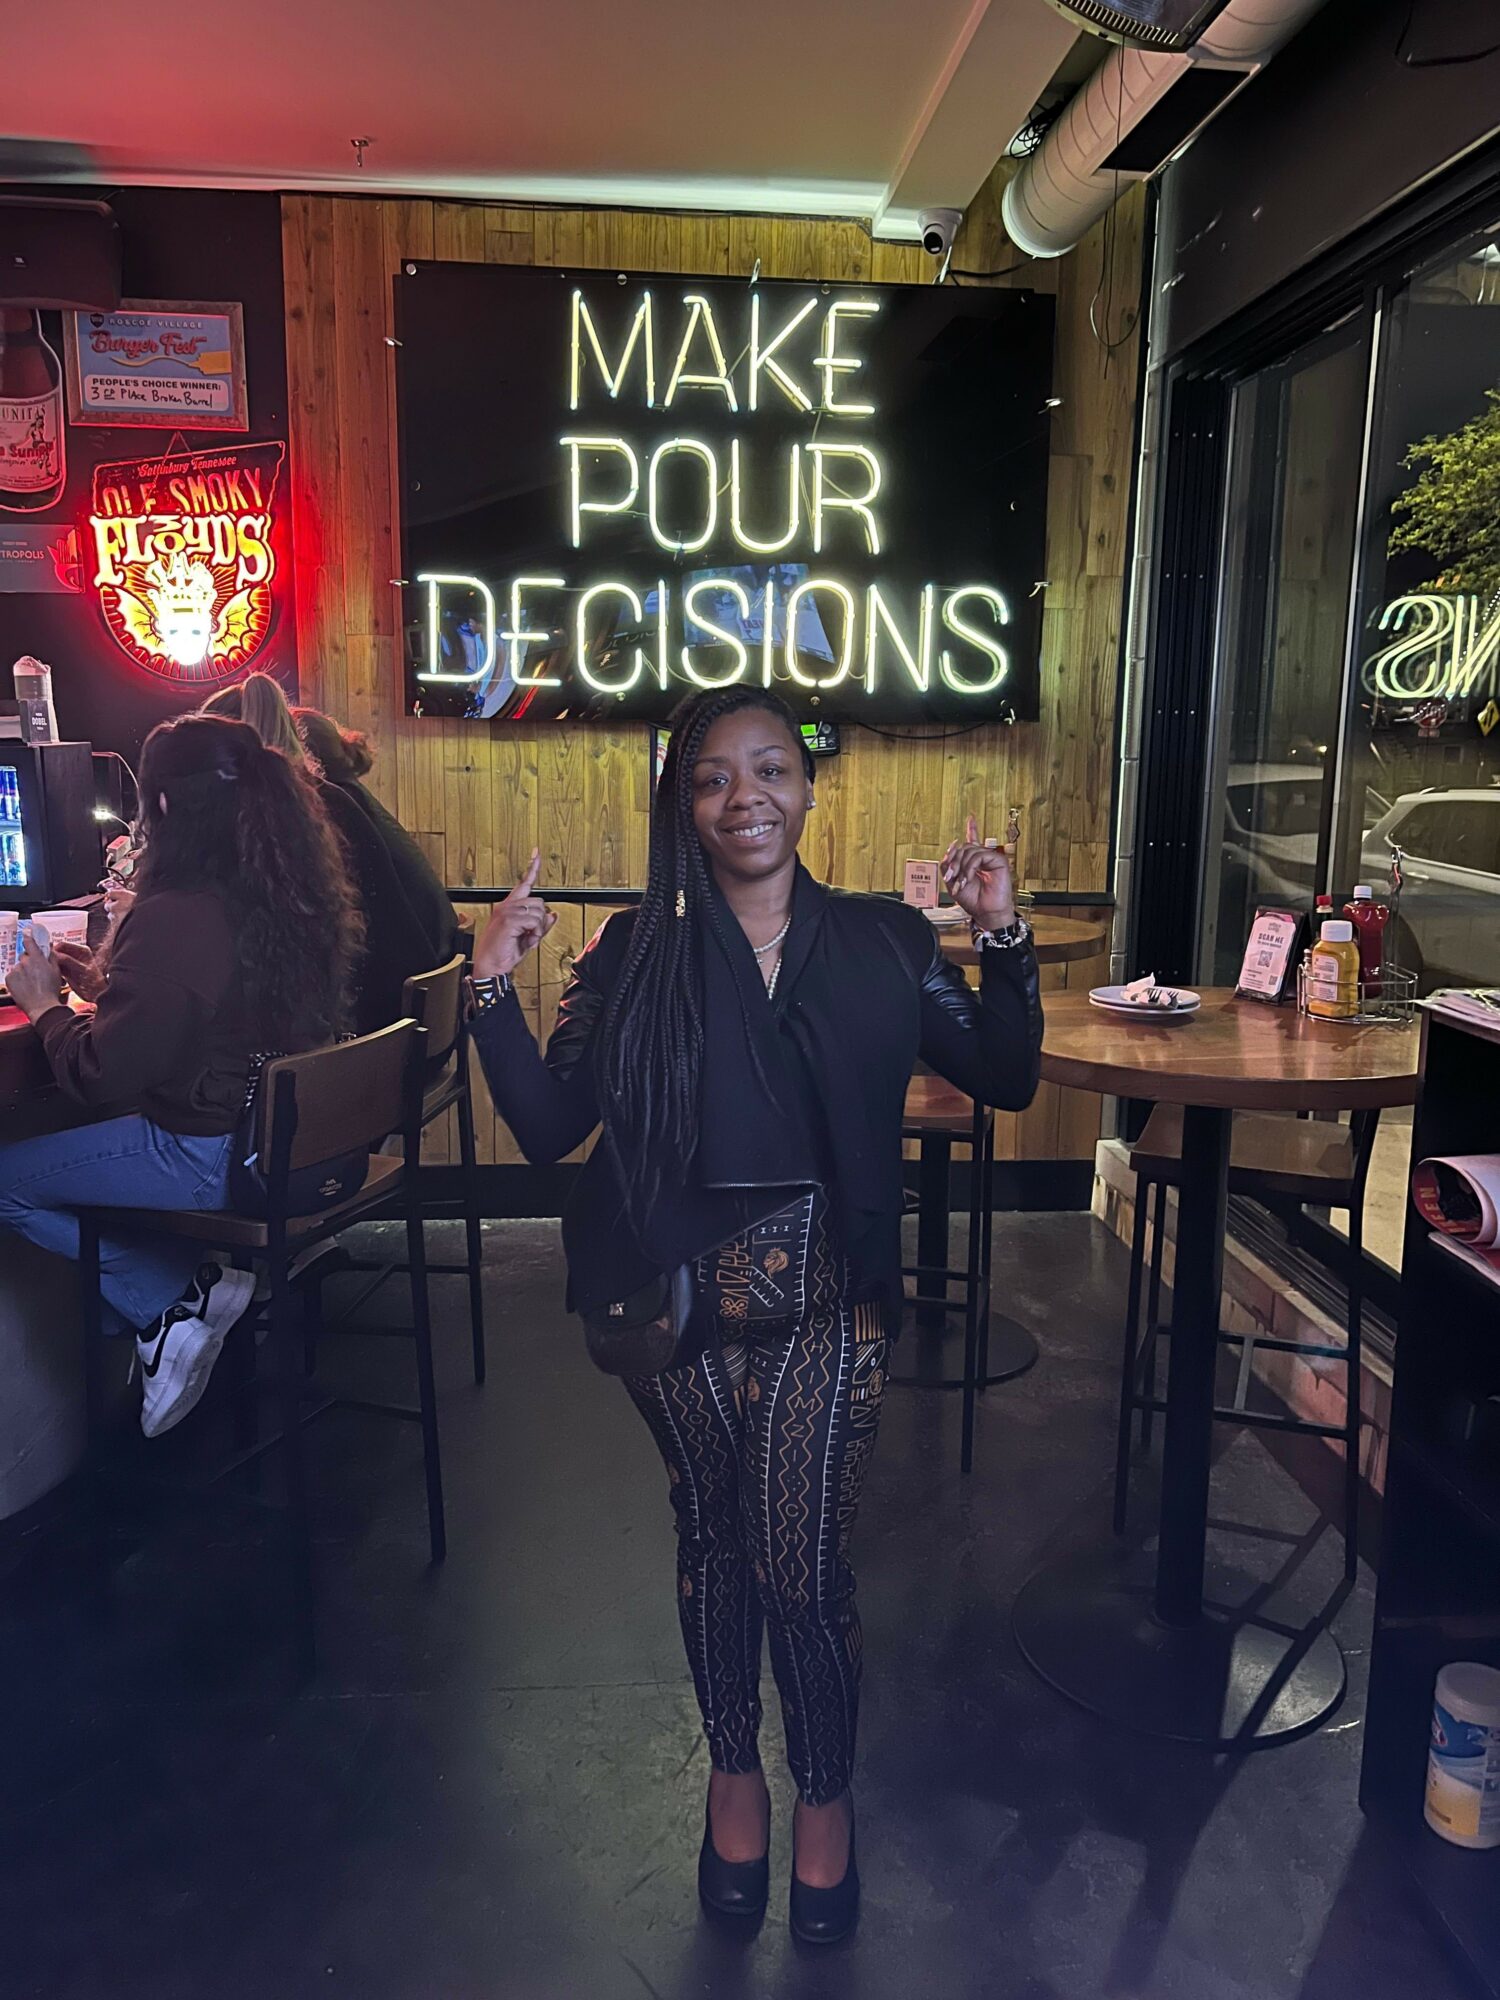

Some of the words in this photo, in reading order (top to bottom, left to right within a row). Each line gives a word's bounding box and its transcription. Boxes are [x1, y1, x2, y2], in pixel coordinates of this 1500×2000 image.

[109, 318, 151, 327] ROSCOE
[157, 320, 203, 329] VILLAGE
[89, 329, 159, 358] Burger
[159, 332, 207, 355] Fest
[568, 289, 881, 414] MAKE
[92, 378, 139, 387] PEOPLE'S
[141, 379, 177, 389] CHOICE
[180, 381, 221, 390] WINNER:
[91, 386, 99, 400] 3
[151, 389, 182, 403] Broken
[183, 391, 213, 408] Barrel
[191, 456, 237, 470] Tennessee
[169, 467, 263, 514] SMOKY
[558, 436, 883, 555] POUR
[416, 573, 1009, 695] DECISIONS
[1258, 932, 1275, 942] SCAN
[1275, 936, 1285, 944] ME
